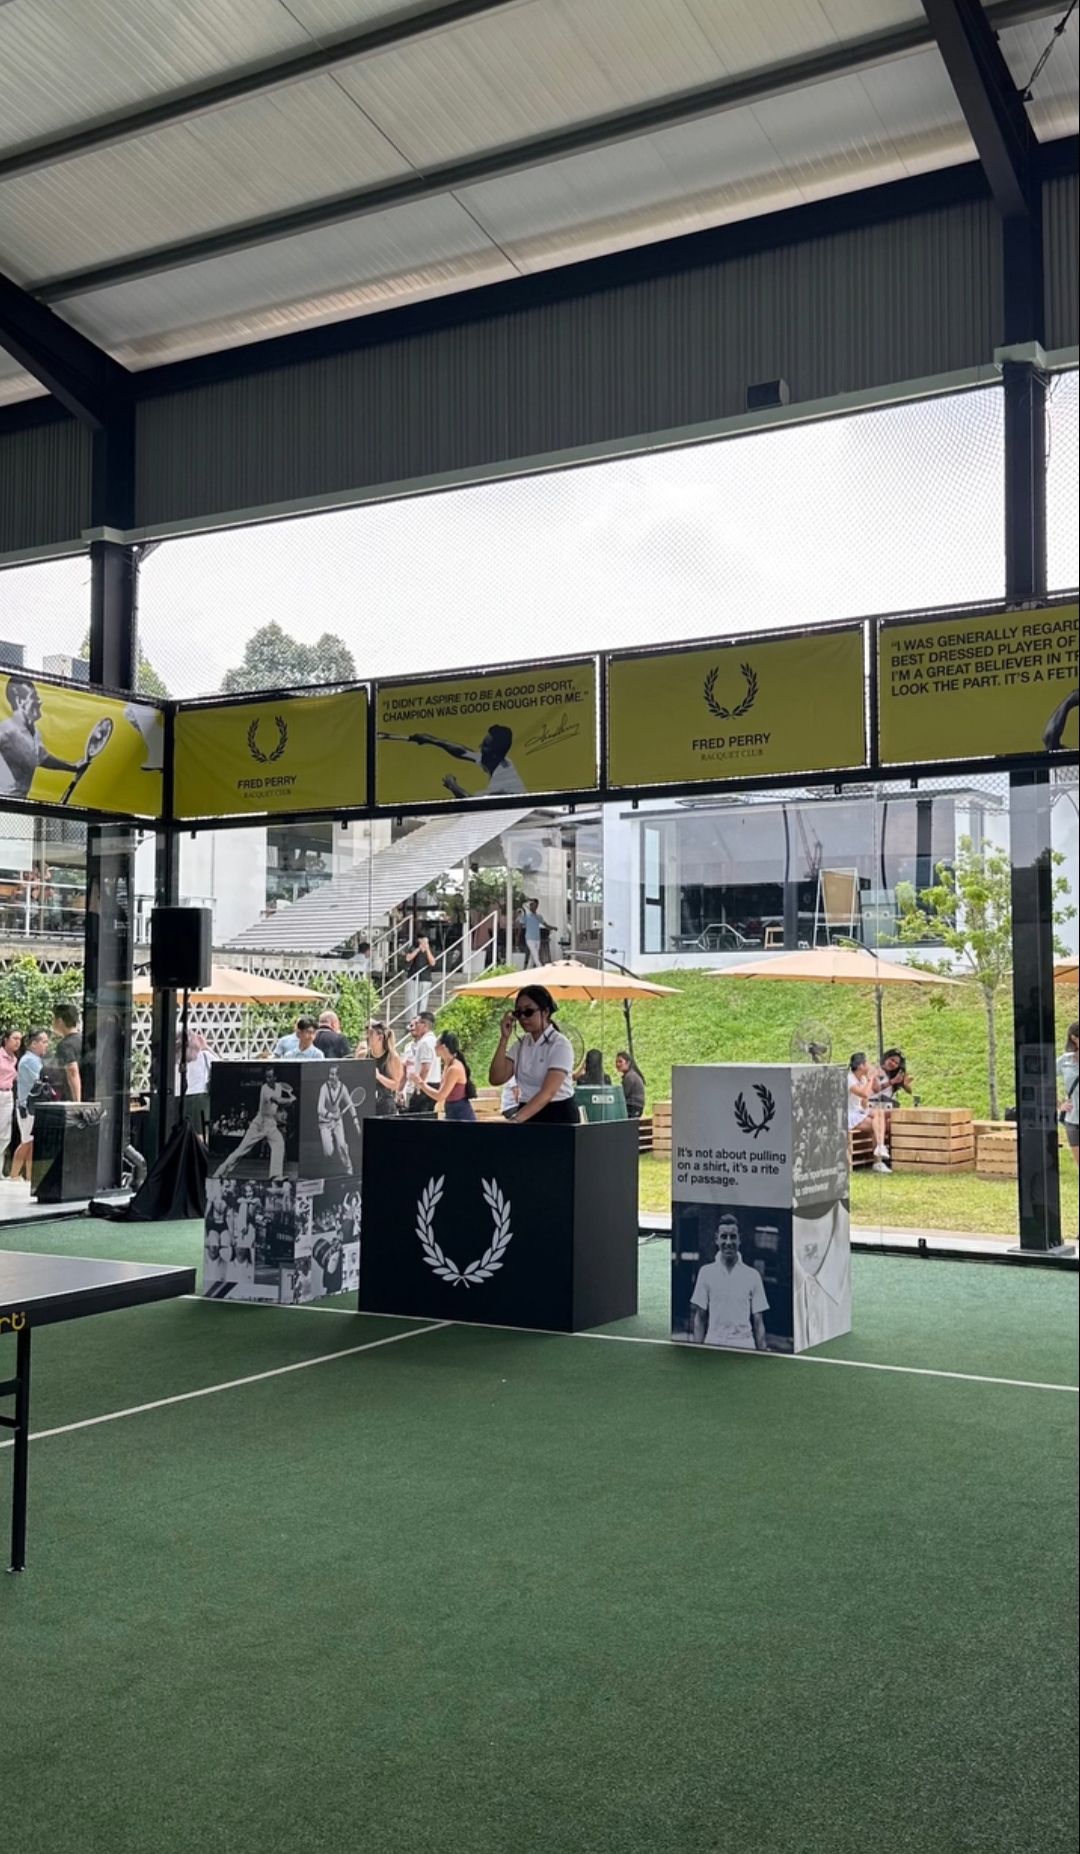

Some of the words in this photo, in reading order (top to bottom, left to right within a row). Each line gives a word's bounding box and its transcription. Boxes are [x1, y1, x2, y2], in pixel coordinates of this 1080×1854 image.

[904, 637, 934, 651] WAS
[937, 627, 1018, 647] GENERALLY
[891, 653, 925, 667] BEST
[929, 646, 994, 664] DRESSED
[997, 638, 1053, 656] PLAYER
[1056, 635, 1076, 648] OF
[891, 668, 910, 682] I'M
[914, 667, 923, 679] A
[926, 663, 971, 678] GREAT
[975, 655, 1043, 673] BELIEVER
[1046, 652, 1061, 665] IN
[891, 683, 929, 697] LOOK
[933, 678, 959, 693] THE
[963, 675, 1001, 689] PART.
[1004, 671, 1030, 686] IT'S
[1033, 669, 1044, 682] A
[392, 696, 423, 709] DIDN'T
[425, 693, 461, 706] ASPIRE
[463, 691, 478, 702] TO
[480, 689, 493, 700] BE
[495, 688, 502, 699] A
[505, 684, 535, 697] GOOD
[537, 679, 576, 693] SPORT,
[382, 708, 434, 722] CHAMPION
[436, 705, 458, 717] WAS
[460, 702, 490, 715] GOOD
[493, 697, 537, 711] ENOUGH
[540, 694, 562, 706] FOR
[692, 737, 726, 751] FRED
[728, 732, 771, 748] PERRY
[701, 750, 740, 761] RACQUET
[741, 748, 764, 758] CLUB
[237, 778, 263, 790] FRED
[264, 775, 297, 787] PERRY
[677, 1147, 693, 1158] It's
[695, 1148, 713, 1159] not
[715, 1148, 747, 1160] about
[749, 1150, 787, 1165] pulling
[677, 1161, 691, 1170] on
[693, 1162, 700, 1171] a
[703, 1160, 730, 1173] shirt,
[732, 1162, 748, 1174] it's
[751, 1165, 758, 1174] a
[761, 1164, 780, 1175] rite
[677, 1172, 688, 1183] of
[690, 1175, 739, 1188] passage.
